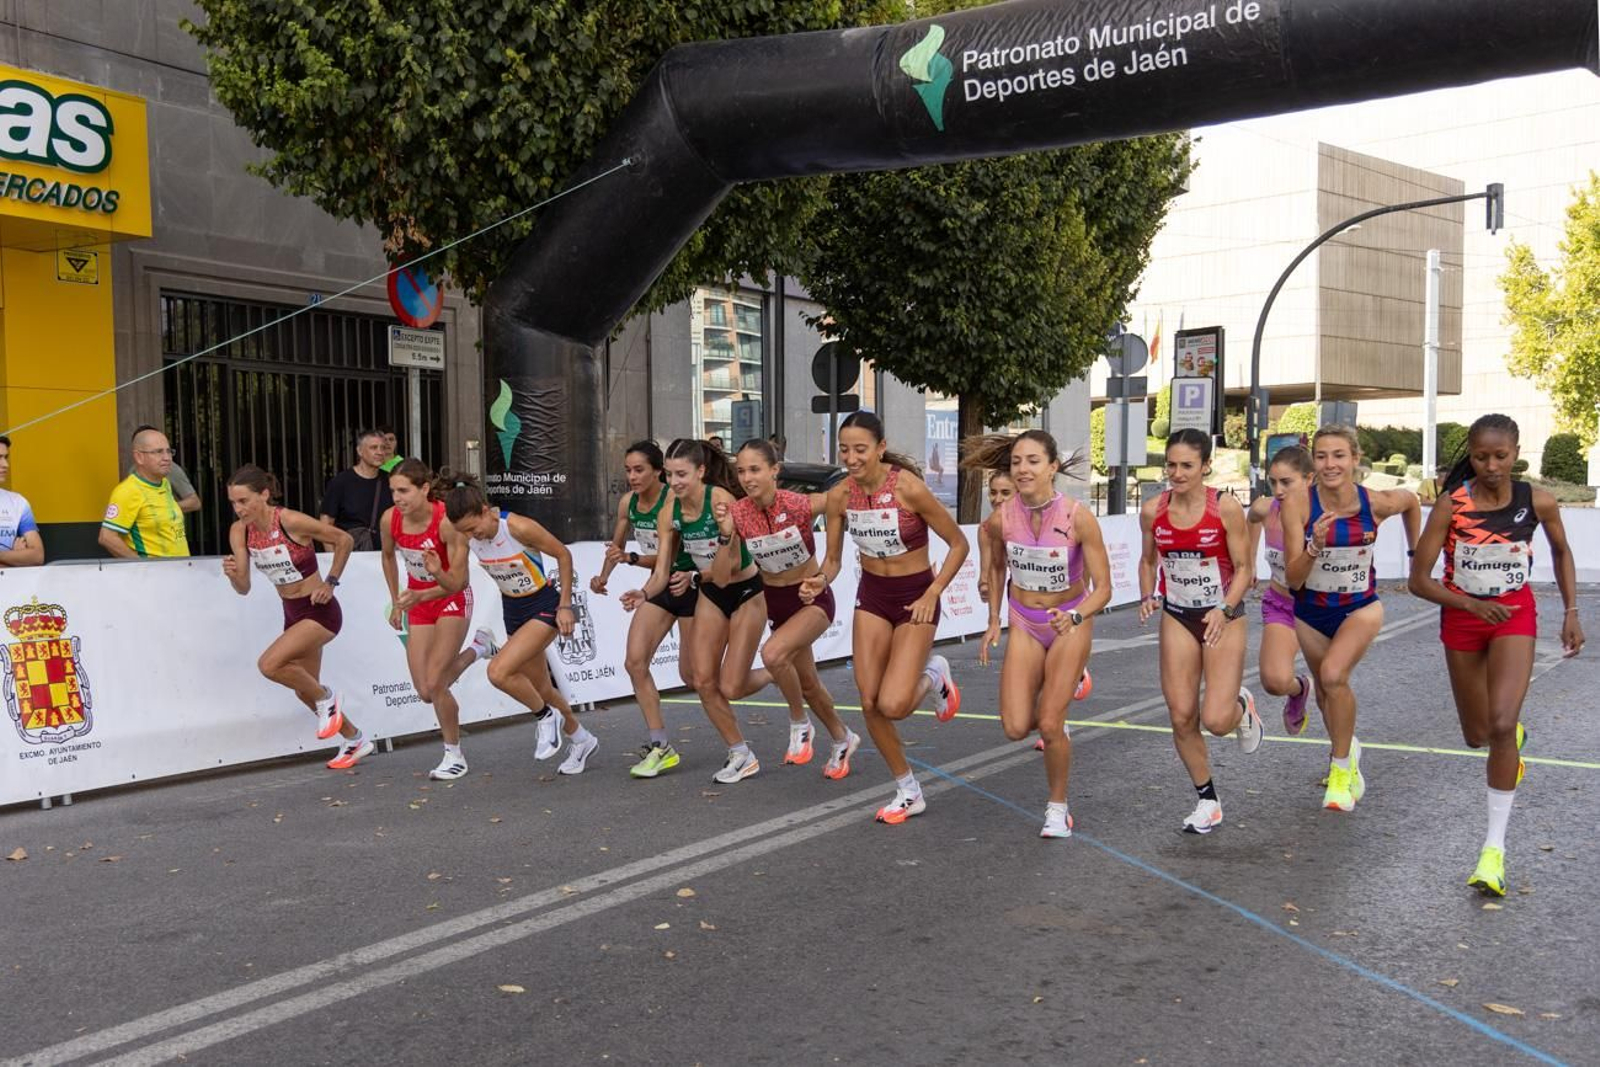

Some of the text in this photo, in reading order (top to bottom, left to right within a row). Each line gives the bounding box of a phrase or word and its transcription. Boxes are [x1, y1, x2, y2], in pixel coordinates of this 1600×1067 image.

[962, 1, 1261, 73] Patronato Municipal de
[963, 44, 1188, 103] Deportes de Jaén
[0, 82, 111, 171] as
[1184, 385, 1200, 407] P
[503, 472, 550, 486] Municipal
[553, 473, 567, 483] de
[512, 485, 525, 494] de
[527, 485, 553, 495] Jaén
[751, 539, 763, 549] 37
[884, 538, 900, 548] 34
[755, 543, 800, 560] Serrano
[791, 548, 804, 560] 31
[1012, 546, 1025, 557] 37
[1462, 546, 1478, 556] 37
[1012, 559, 1064, 573] Gallardo
[1165, 560, 1175, 569] 37
[1321, 562, 1360, 573] Costa
[1461, 559, 1522, 572] Kimugo
[517, 577, 531, 588] 29
[1050, 573, 1066, 585] 30
[1171, 574, 1211, 587] Espejo
[1351, 571, 1366, 583] 38
[1505, 572, 1525, 584] 39
[1202, 585, 1219, 597] 37
[582, 670, 593, 682] DE
[372, 680, 412, 696] Patronato
[385, 691, 422, 707] Deportes
[49, 741, 102, 756] AYUNTAMIENTO
[47, 756, 58, 766] DE
